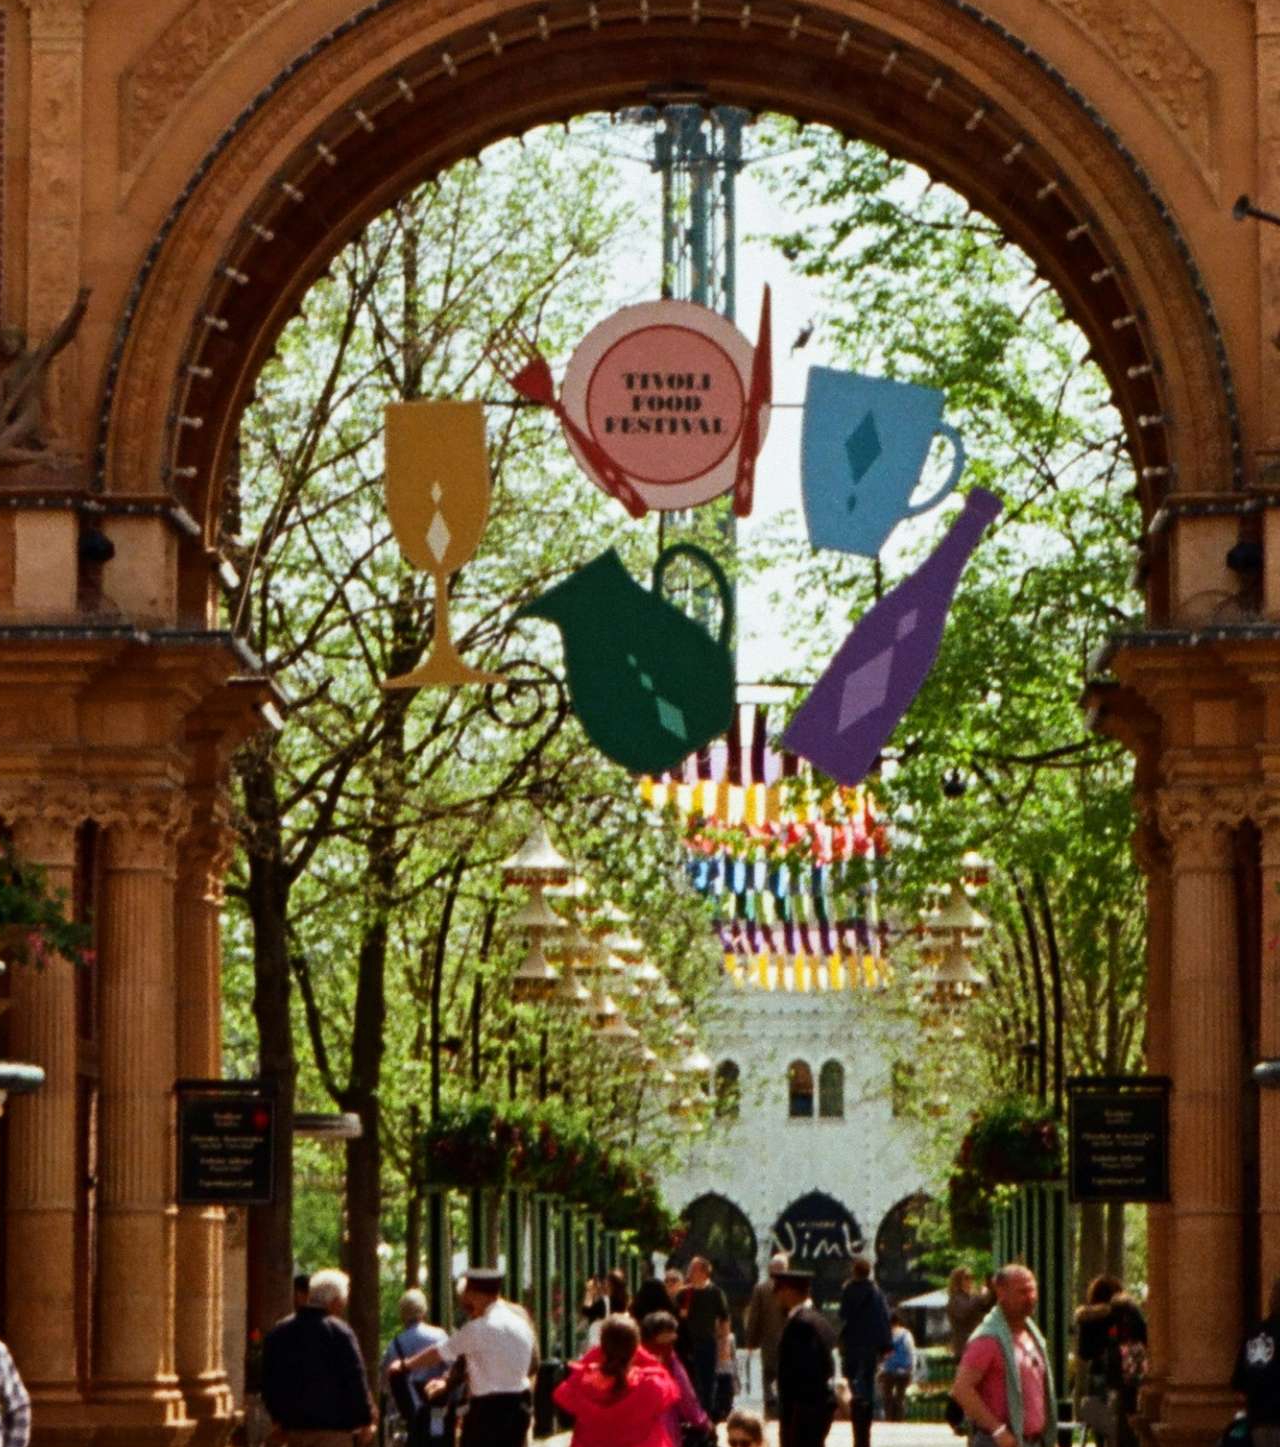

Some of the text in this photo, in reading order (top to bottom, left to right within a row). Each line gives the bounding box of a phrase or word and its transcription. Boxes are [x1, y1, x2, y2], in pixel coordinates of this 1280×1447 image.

[623, 372, 711, 390] TIVOLI
[632, 395, 702, 412] FOOD
[605, 417, 726, 434] FESTIVAL
[770, 1221, 866, 1258] Nimb
